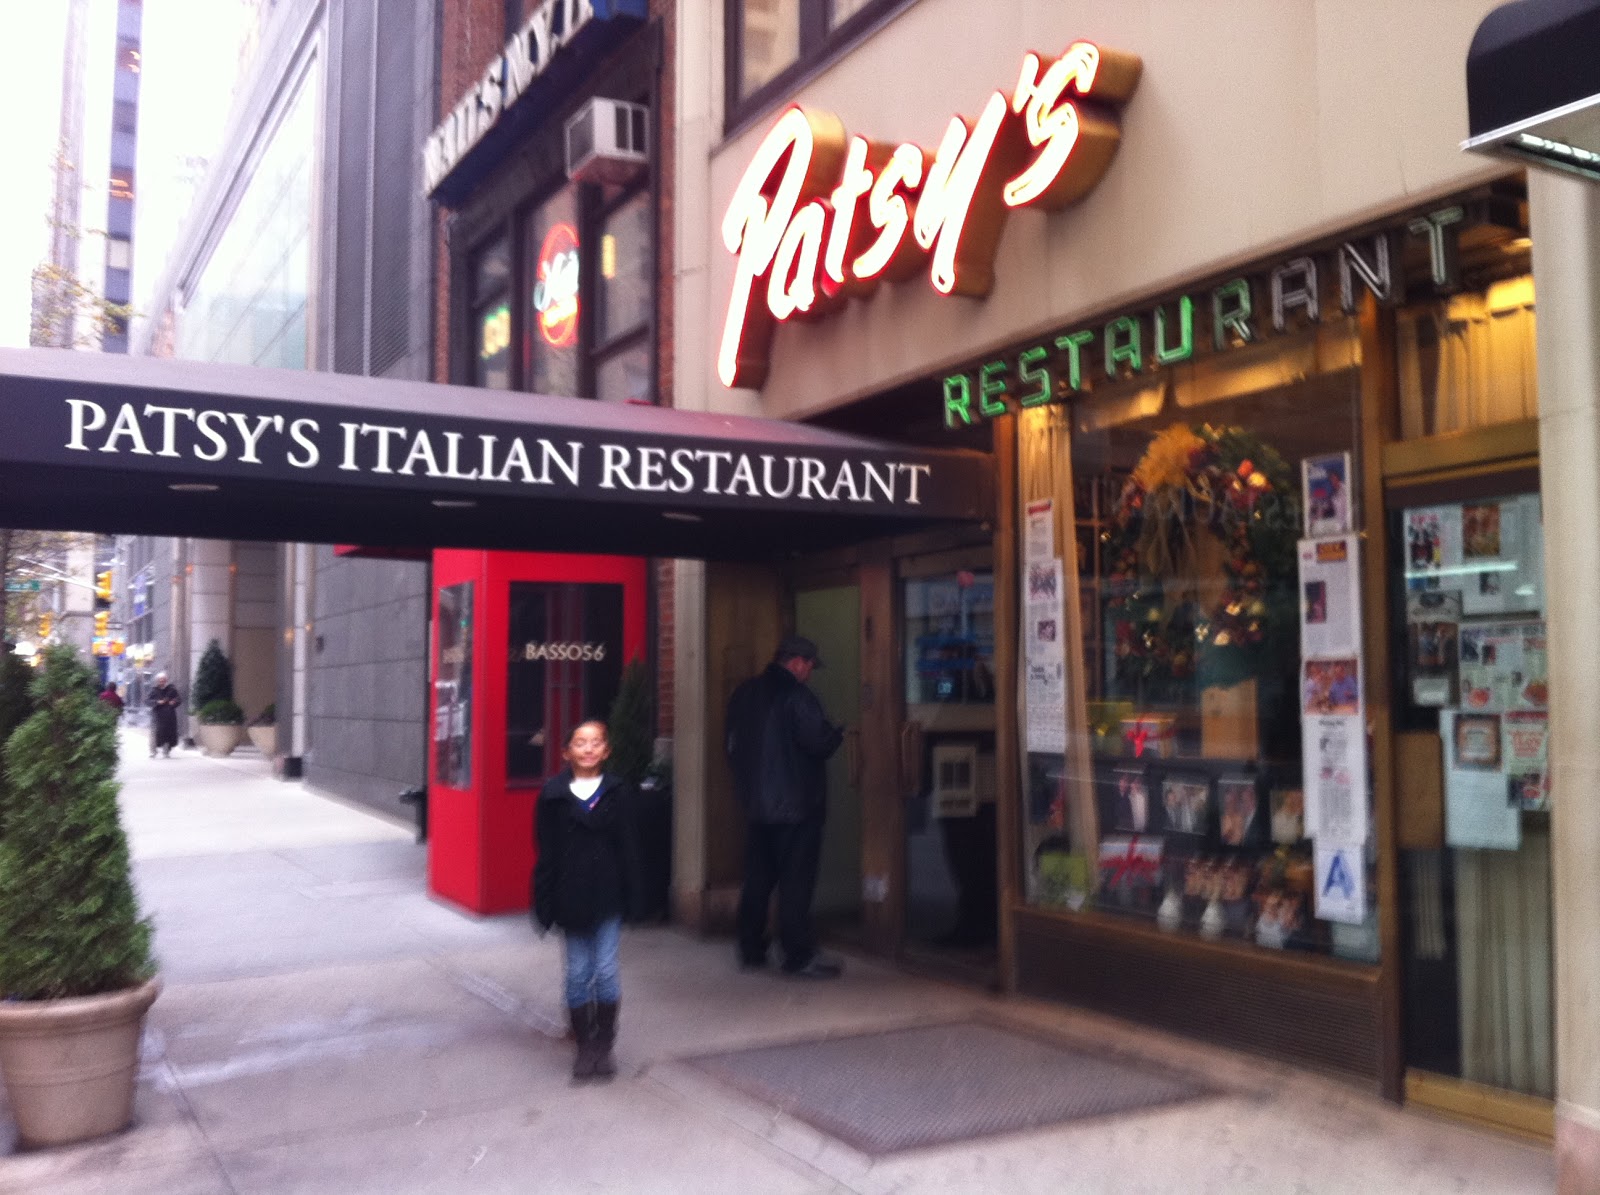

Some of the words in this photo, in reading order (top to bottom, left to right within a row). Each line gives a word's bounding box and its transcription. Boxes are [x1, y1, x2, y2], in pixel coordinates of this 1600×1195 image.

[717, 40, 1101, 388] Patsy's
[942, 206, 1463, 428] RESTAURANT
[65, 398, 321, 469] PATSY'S
[338, 422, 582, 485] ITALIAN
[599, 444, 931, 505] RESTAURANT
[525, 642, 606, 661] BASSO56
[1323, 850, 1354, 899] A
